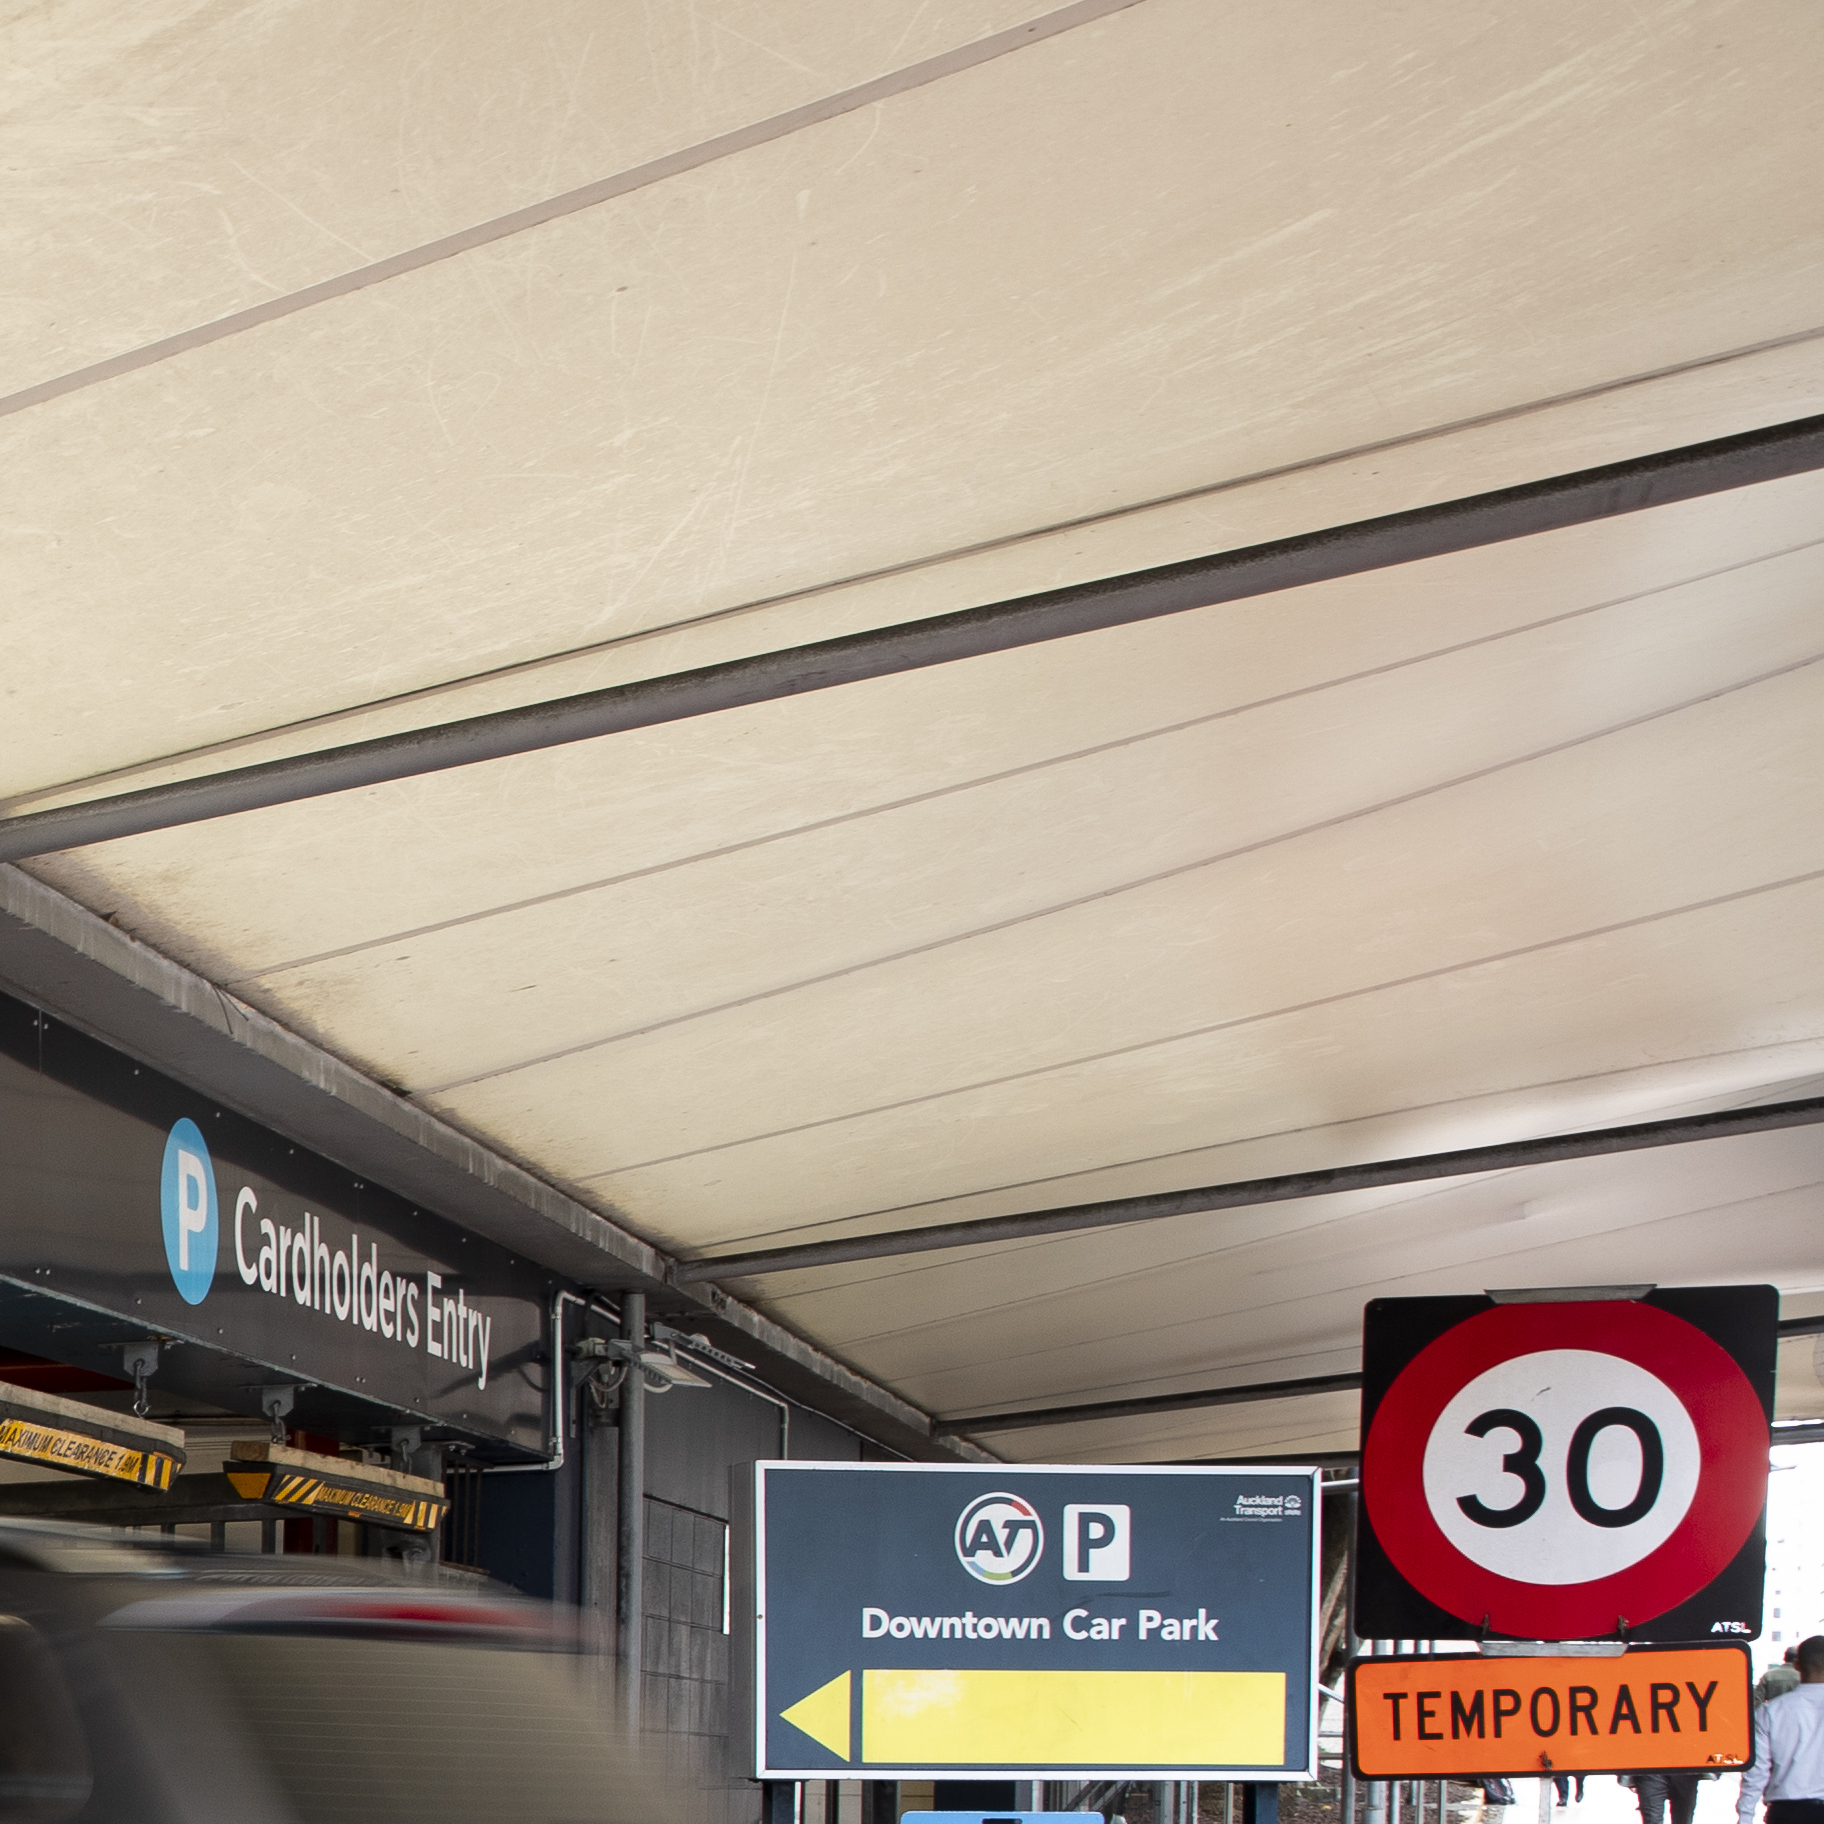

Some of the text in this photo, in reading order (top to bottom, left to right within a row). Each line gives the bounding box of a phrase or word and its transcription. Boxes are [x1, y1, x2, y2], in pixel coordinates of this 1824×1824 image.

[177, 1148, 492, 1391] P Cardholders Entry
[50, 1437, 118, 1468] CLEARANCE
[1455, 1405, 1665, 1529] 30
[1233, 1505, 1284, 1517] Transport
[1236, 1494, 1284, 1506] Auckland
[1077, 1511, 1116, 1574] P
[862, 1607, 1220, 1641] Downtown Car Park
[1382, 1680, 1719, 1742] TEMPORARY
